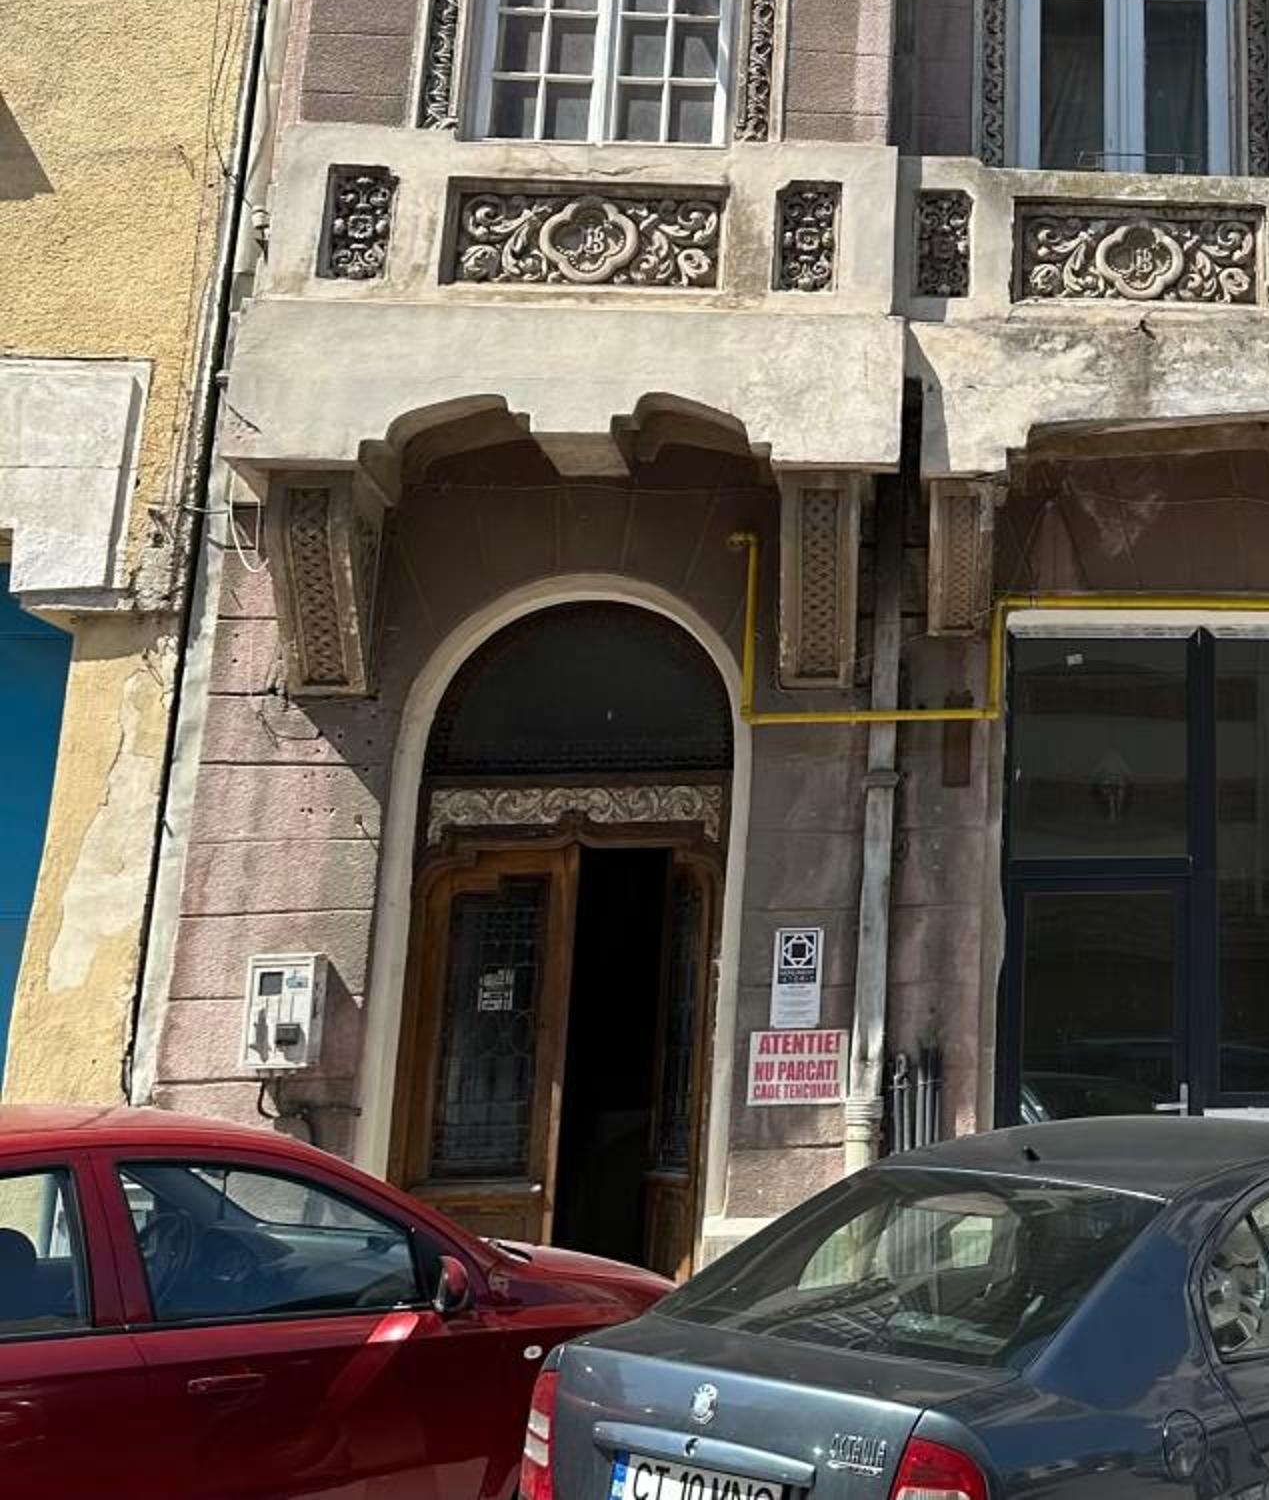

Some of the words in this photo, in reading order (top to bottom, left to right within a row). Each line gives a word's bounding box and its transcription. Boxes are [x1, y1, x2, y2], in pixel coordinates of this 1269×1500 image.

[758, 1033, 839, 1054] ATENTIE!
[754, 1061, 775, 1081] NU
[778, 1060, 839, 1080] PARCATI
[633, 1462, 670, 1500] CT
[680, 1471, 705, 1500] 10
